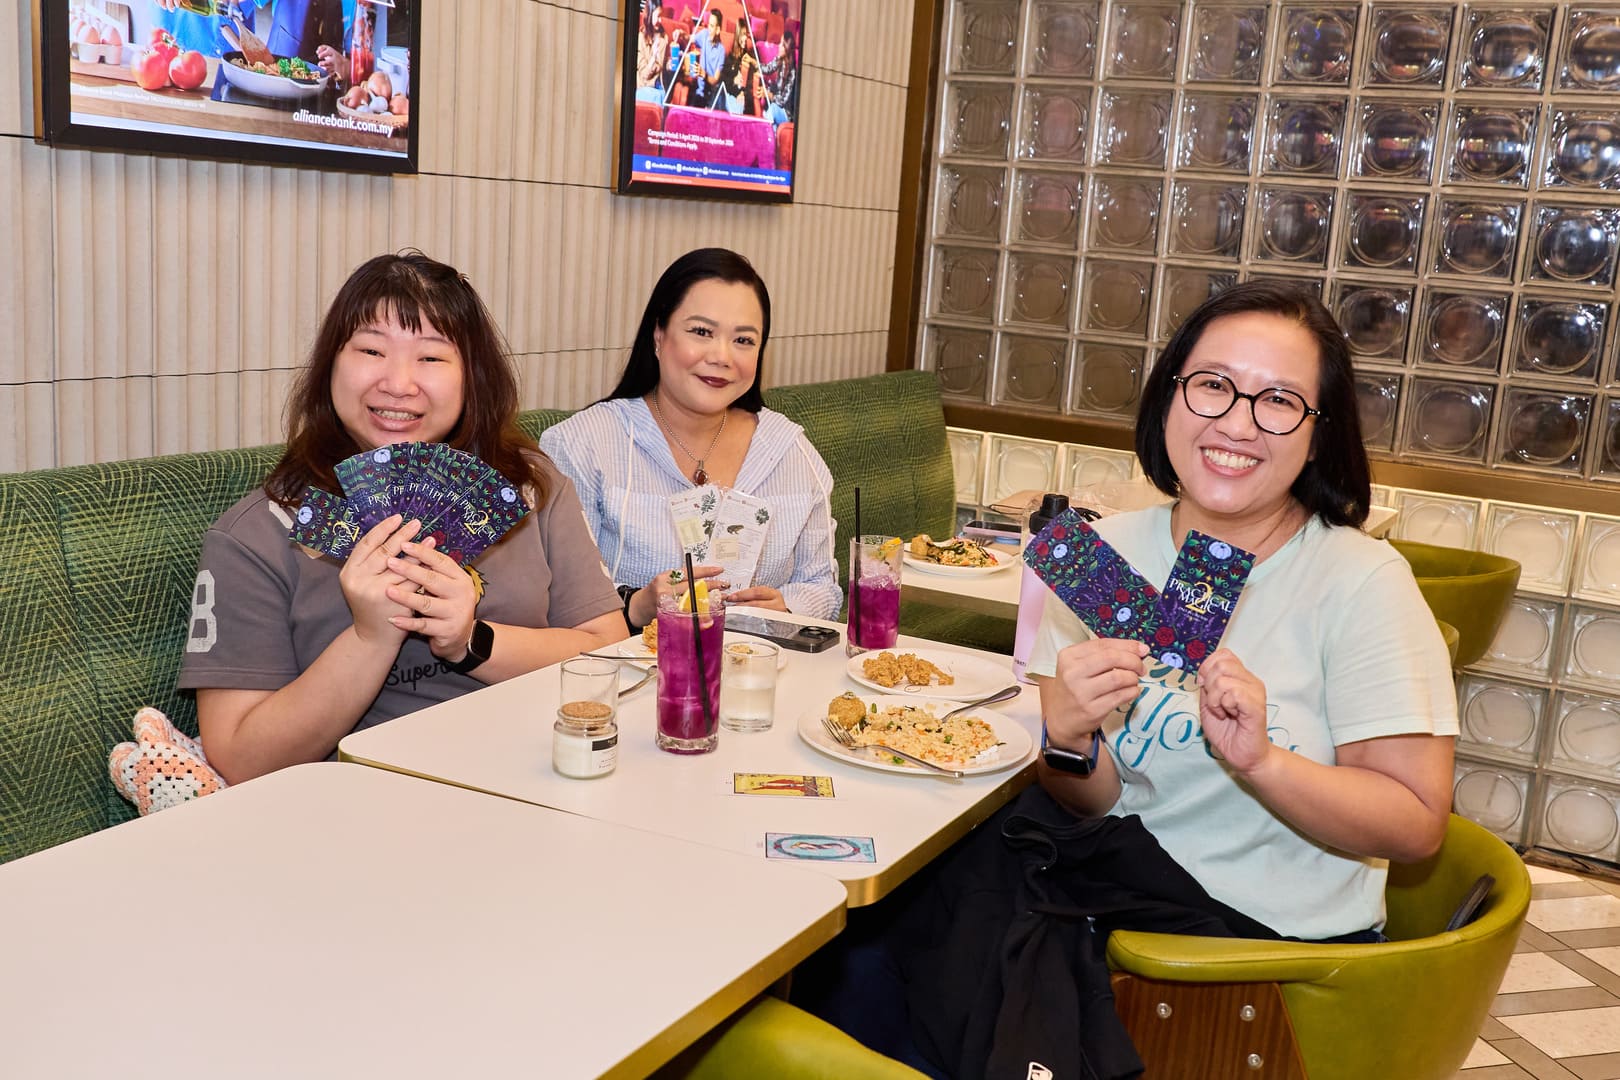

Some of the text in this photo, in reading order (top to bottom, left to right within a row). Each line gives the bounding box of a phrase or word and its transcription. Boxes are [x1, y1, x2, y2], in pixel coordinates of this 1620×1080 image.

[293, 109, 393, 138] alliancebank.com.my
[667, 139, 686, 148] Conditions
[1185, 581, 1213, 615] 2
